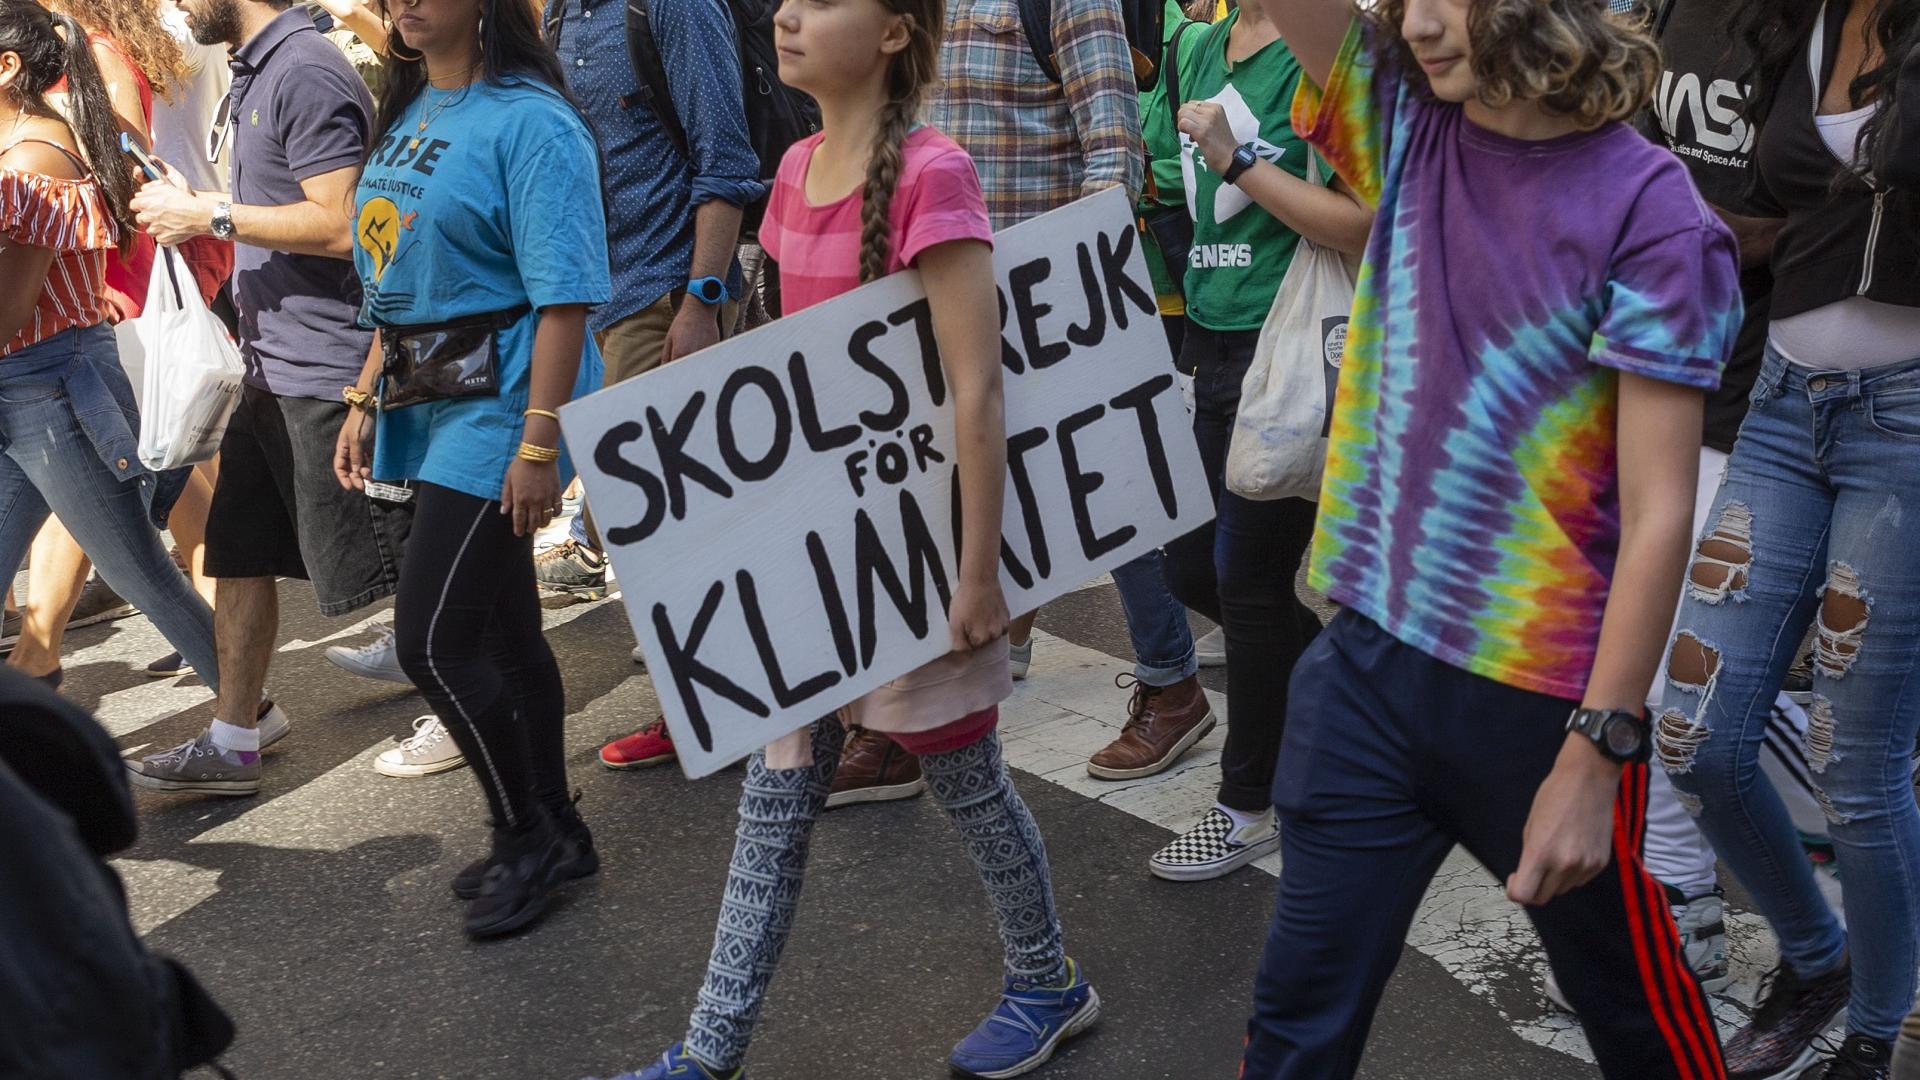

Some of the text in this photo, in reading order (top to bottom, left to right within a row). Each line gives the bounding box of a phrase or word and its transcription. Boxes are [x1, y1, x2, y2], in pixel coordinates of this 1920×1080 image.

[368, 134, 451, 176] RISE
[1691, 147, 1703, 158] and
[1703, 150, 1728, 164] Space
[387, 179, 425, 200] JUSTICE
[1188, 243, 1252, 269] ENEWS
[845, 423, 945, 498] FÖR
